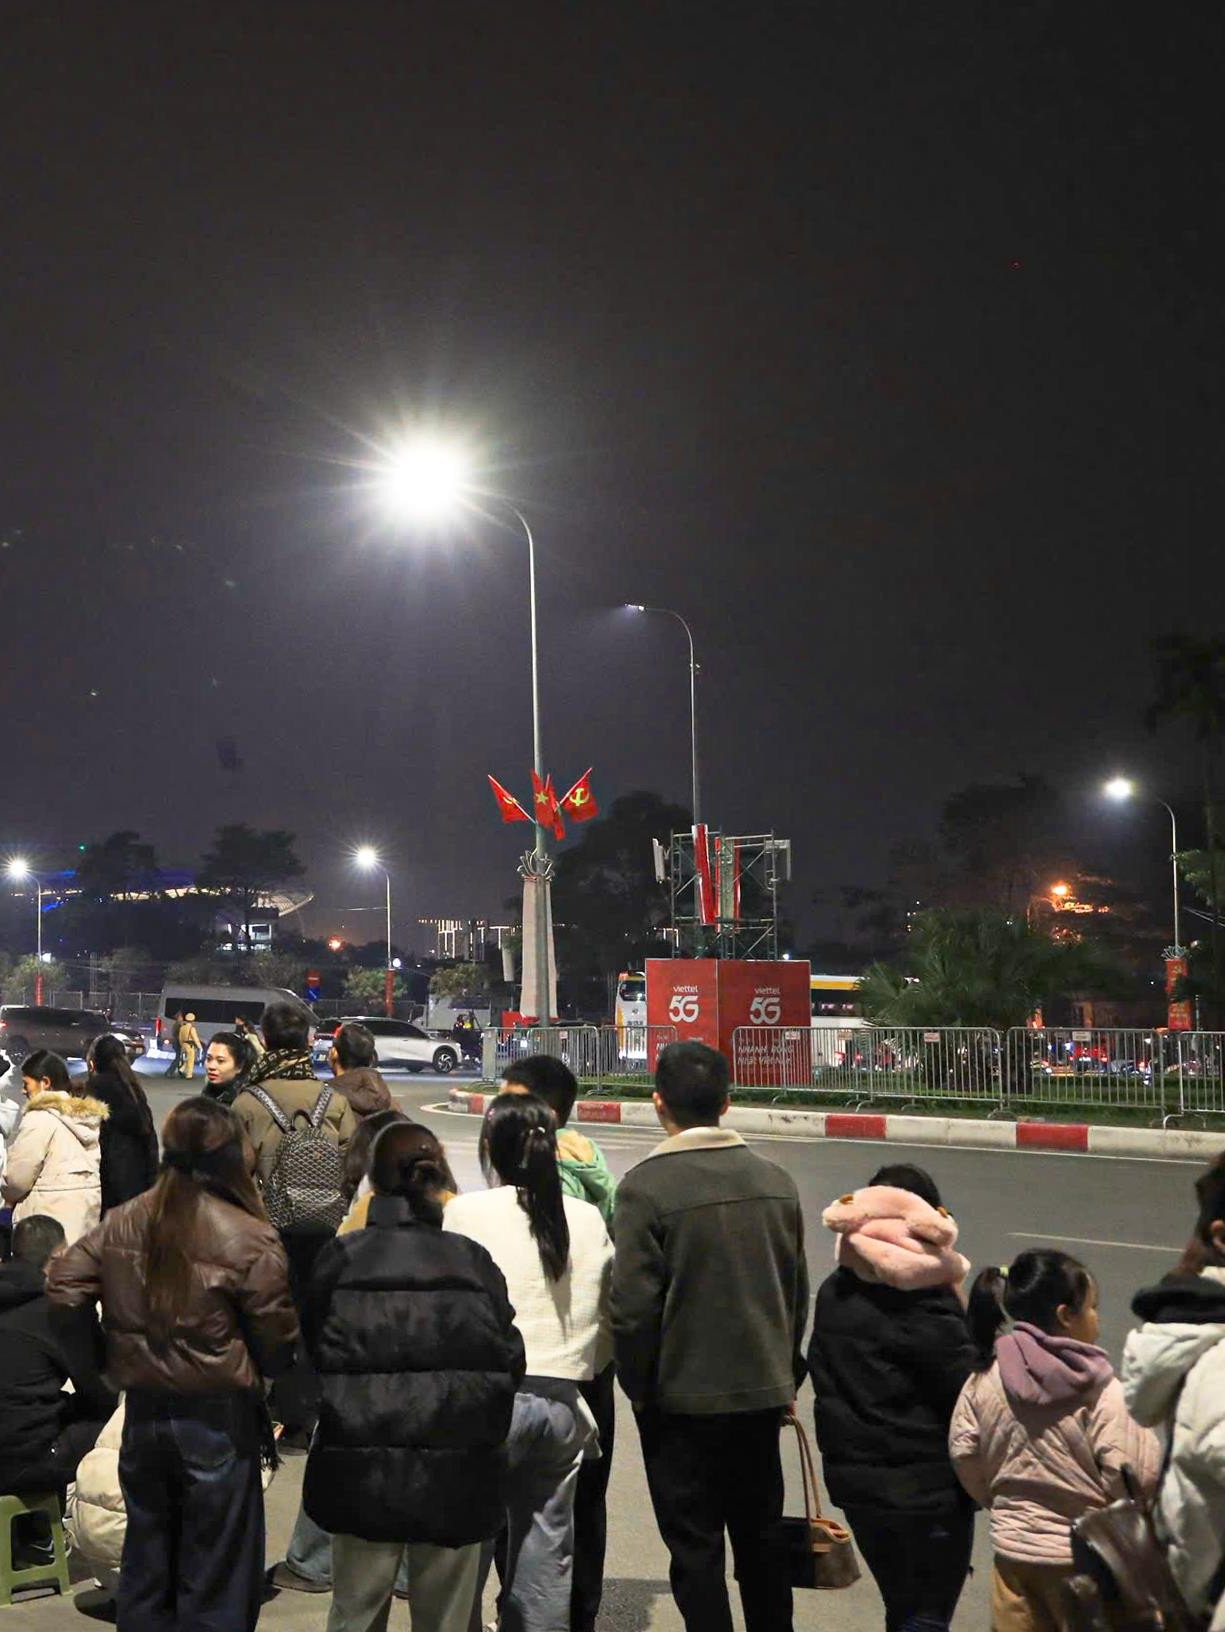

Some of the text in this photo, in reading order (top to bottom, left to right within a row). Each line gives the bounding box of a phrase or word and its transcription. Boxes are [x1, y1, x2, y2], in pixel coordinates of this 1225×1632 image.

[673, 985, 698, 993] viettel
[755, 987, 780, 995] viettel
[669, 995, 699, 1022] 5G
[750, 997, 781, 1024] 5G
